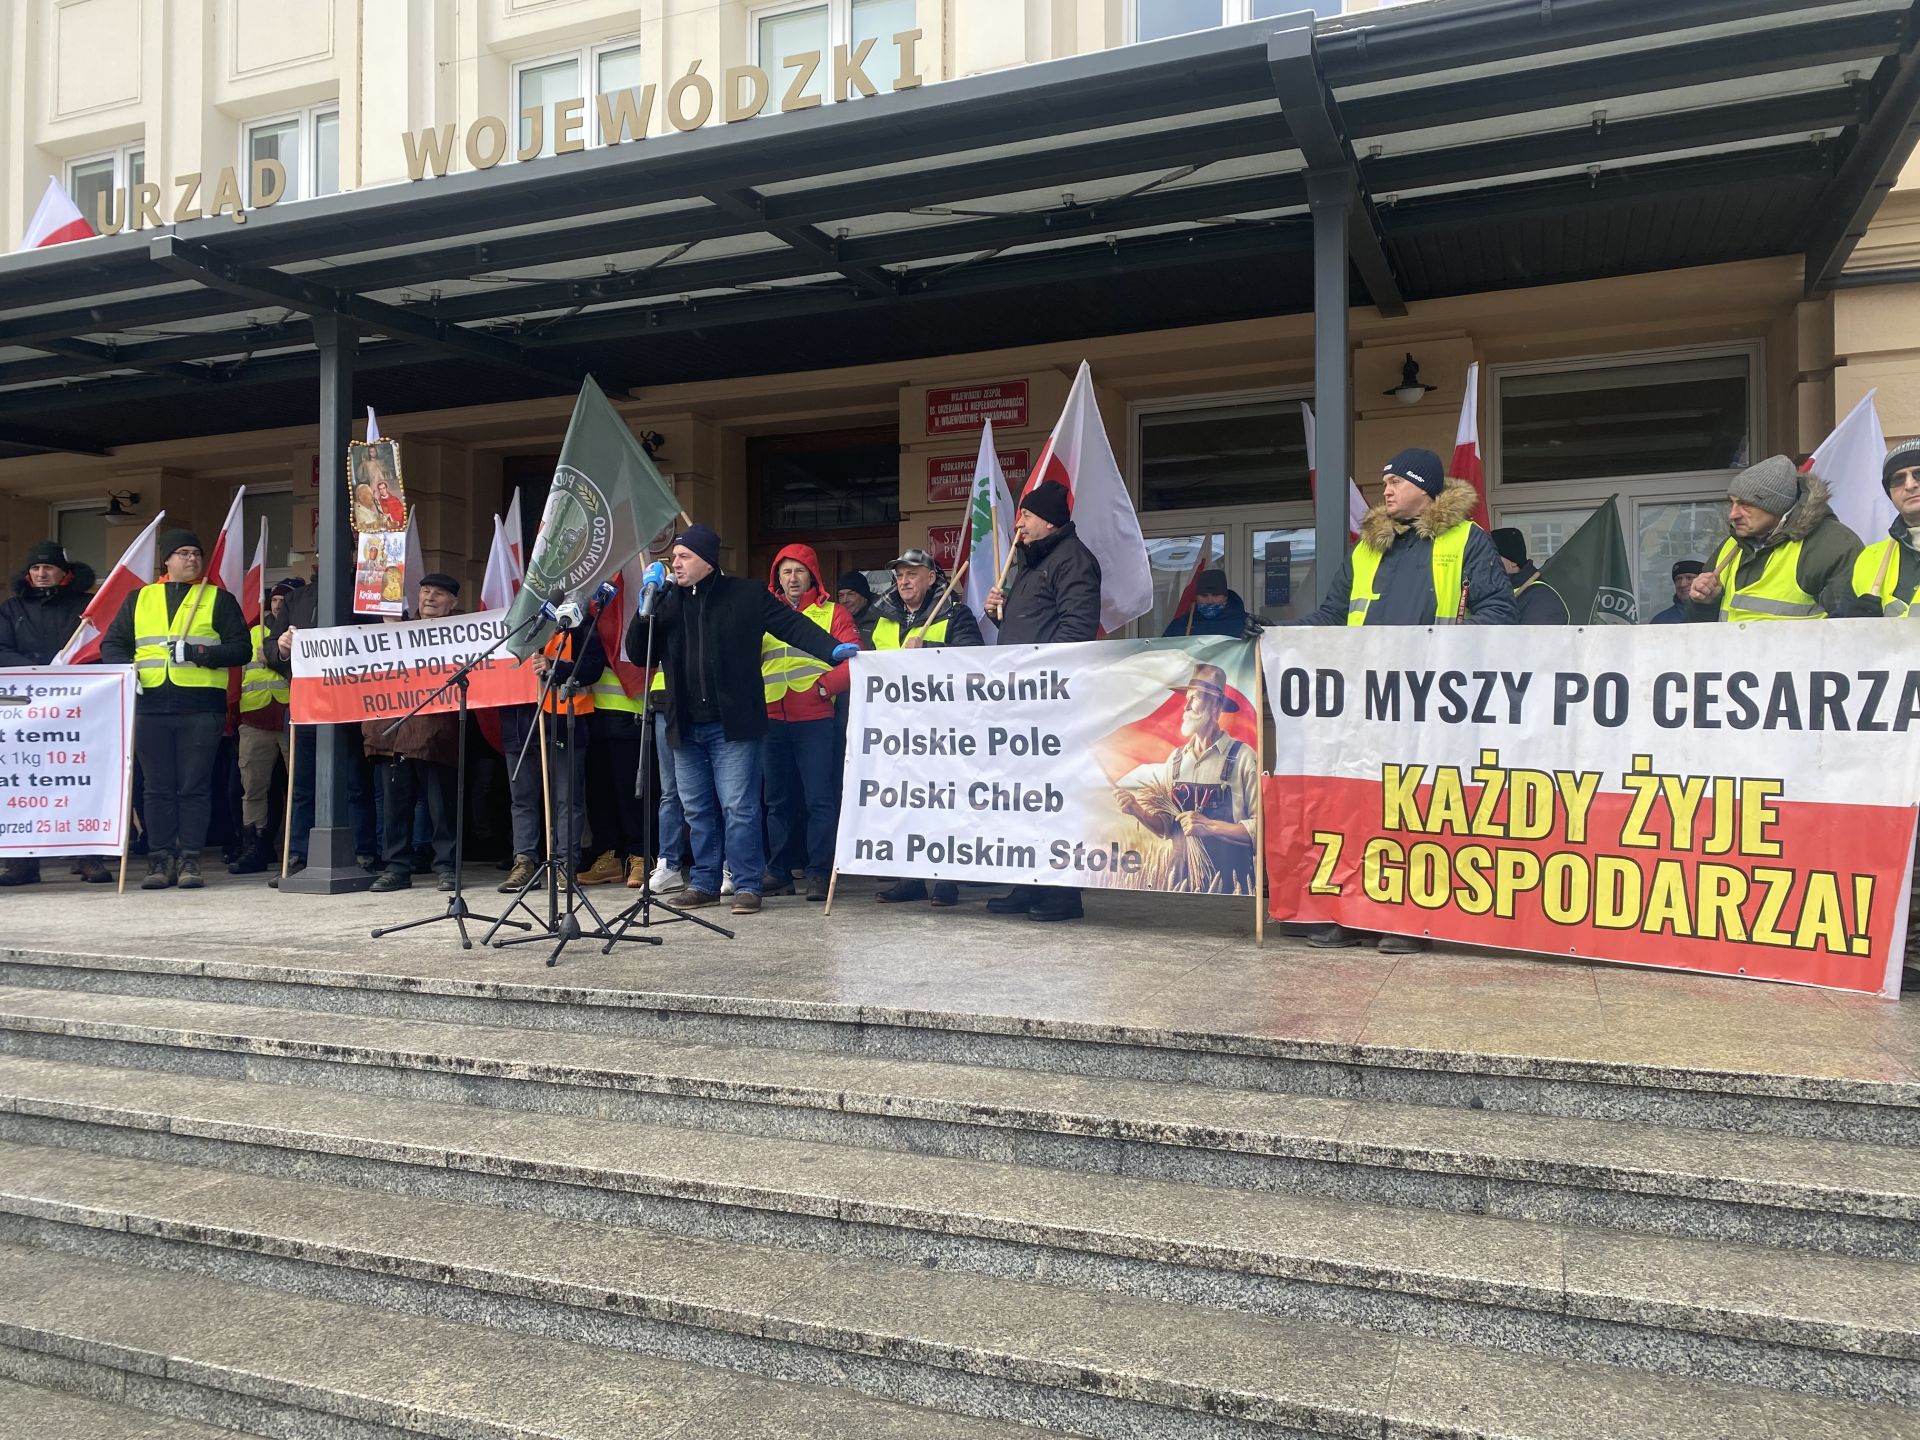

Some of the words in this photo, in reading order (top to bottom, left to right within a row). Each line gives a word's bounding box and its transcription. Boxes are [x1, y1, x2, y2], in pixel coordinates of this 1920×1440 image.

[96, 158, 286, 236] URZĄD
[402, 28, 923, 181] WOJEWÓDZKI
[300, 637, 360, 659] UMOWA
[363, 632, 391, 654] UE
[396, 631, 402, 650] I
[408, 620, 511, 648] MERCOSU
[322, 660, 409, 687] ZNISZCZĄ
[415, 650, 496, 677] POLSKIE
[0, 684, 18, 697] at
[27, 684, 82, 698] temu
[866, 673, 954, 703] Polski
[965, 670, 1071, 702] Rolnik
[1280, 667, 1345, 718] OD
[1365, 670, 1534, 726] MYSZY
[1554, 672, 1629, 729] PO
[28, 706, 60, 719] 610
[66, 706, 82, 719] zł
[15, 728, 81, 743] temu
[862, 727, 976, 755] Polskie
[988, 726, 1061, 756] Pole
[14, 751, 41, 767] 1kg
[48, 751, 67, 764] 10
[72, 751, 86, 764] zł
[0, 774, 19, 787] at
[28, 773, 91, 787] temu
[859, 779, 955, 810] Polski
[968, 781, 1064, 812] Chleb
[7, 796, 48, 808] 4600
[54, 796, 69, 808] zł
[1381, 748, 1602, 844] KAŻDY
[1621, 753, 1784, 858] ŻYJE
[36, 819, 51, 833] 25
[55, 819, 70, 833] lat
[78, 819, 99, 832] 580
[103, 818, 112, 832] zł
[855, 838, 893, 861] na
[906, 834, 1036, 868] Polskim
[1049, 839, 1142, 874] Stole
[1309, 829, 1345, 896] Z
[1363, 837, 1876, 958] GOSPODARZA!
